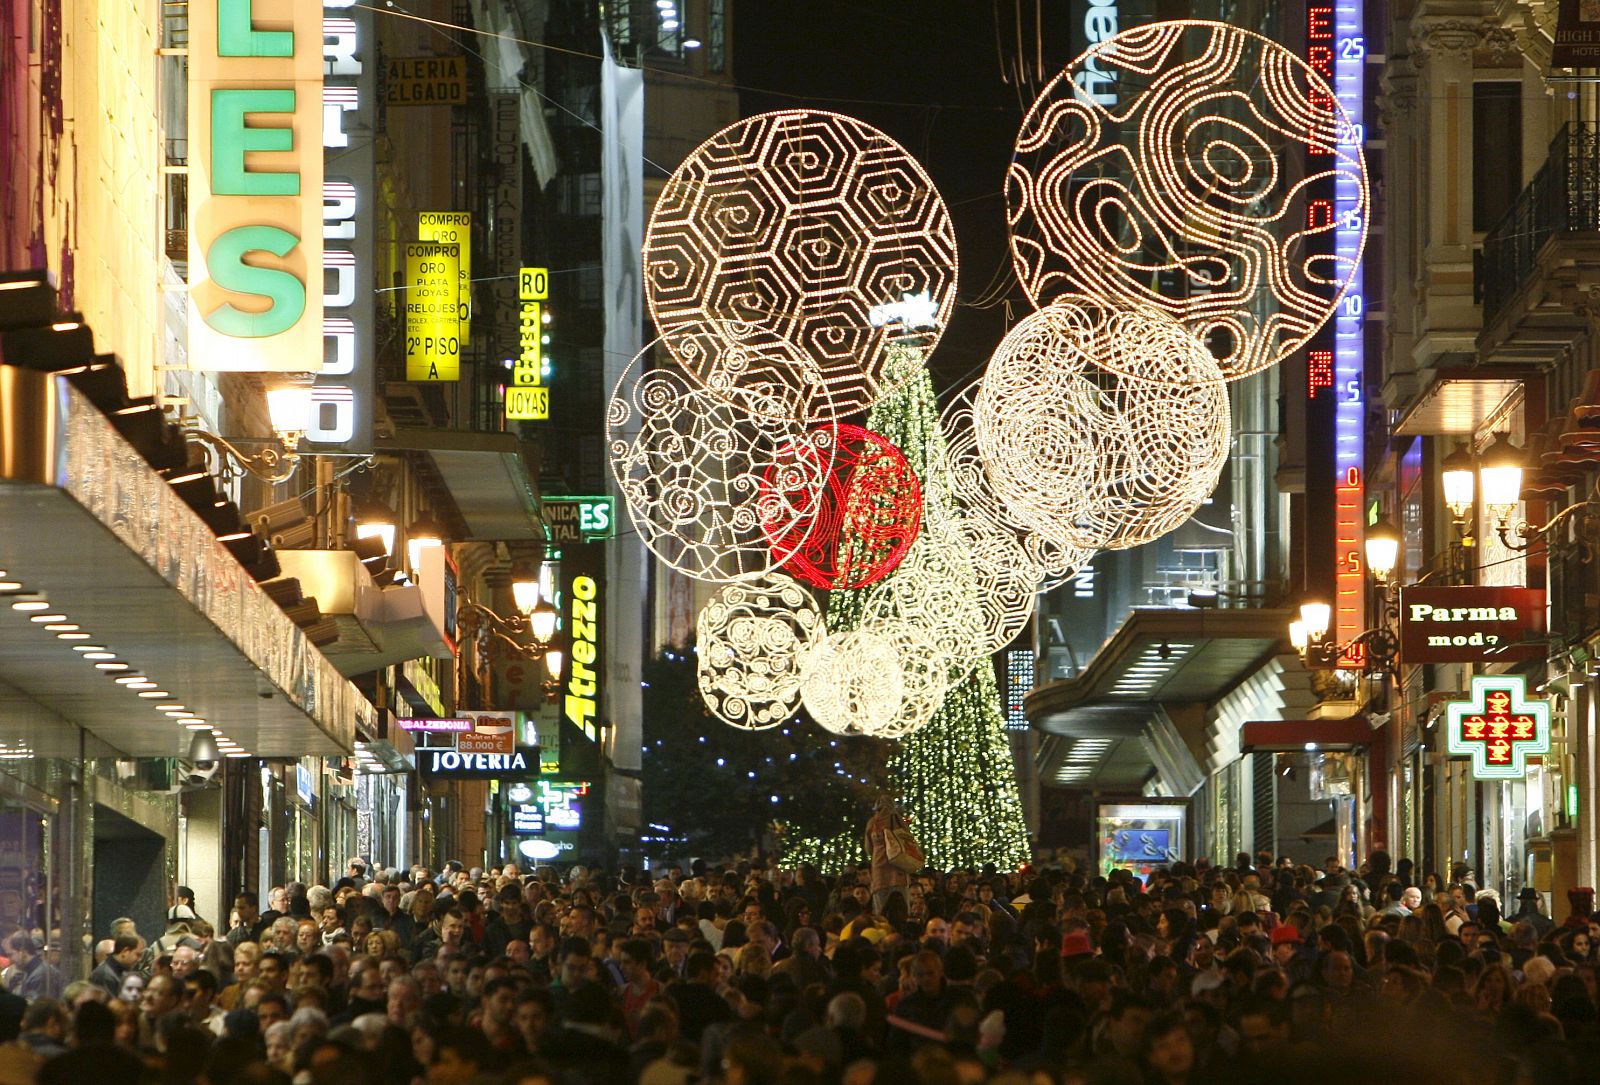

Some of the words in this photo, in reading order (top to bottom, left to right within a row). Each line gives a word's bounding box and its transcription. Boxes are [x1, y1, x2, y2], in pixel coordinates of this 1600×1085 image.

[1557, 30, 1592, 42] HIGH
[1342, 37, 1364, 58] 25
[1342, 124, 1363, 144] 20
[419, 214, 470, 226] COMPRO
[1345, 210, 1362, 230] 15
[433, 230, 458, 242] ORO
[407, 246, 459, 258] COMPRO
[419, 262, 446, 274] ORO
[416, 278, 449, 287] PLATA
[416, 288, 449, 297] JOYAS
[521, 272, 546, 294] RO
[1344, 294, 1362, 316] 10
[424, 337, 459, 356] PISO
[520, 302, 535, 384] COMPRO
[428, 361, 439, 380] A
[508, 386, 547, 414] JOYAS
[1347, 381, 1360, 402] 5
[1347, 466, 1359, 486] 0
[578, 503, 610, 531] ES
[1409, 604, 1518, 622] Parma
[565, 575, 597, 742] Atrezzo
[459, 741, 494, 751] 88.000
[496, 741, 504, 751] €
[432, 752, 527, 772] JOYERIA
